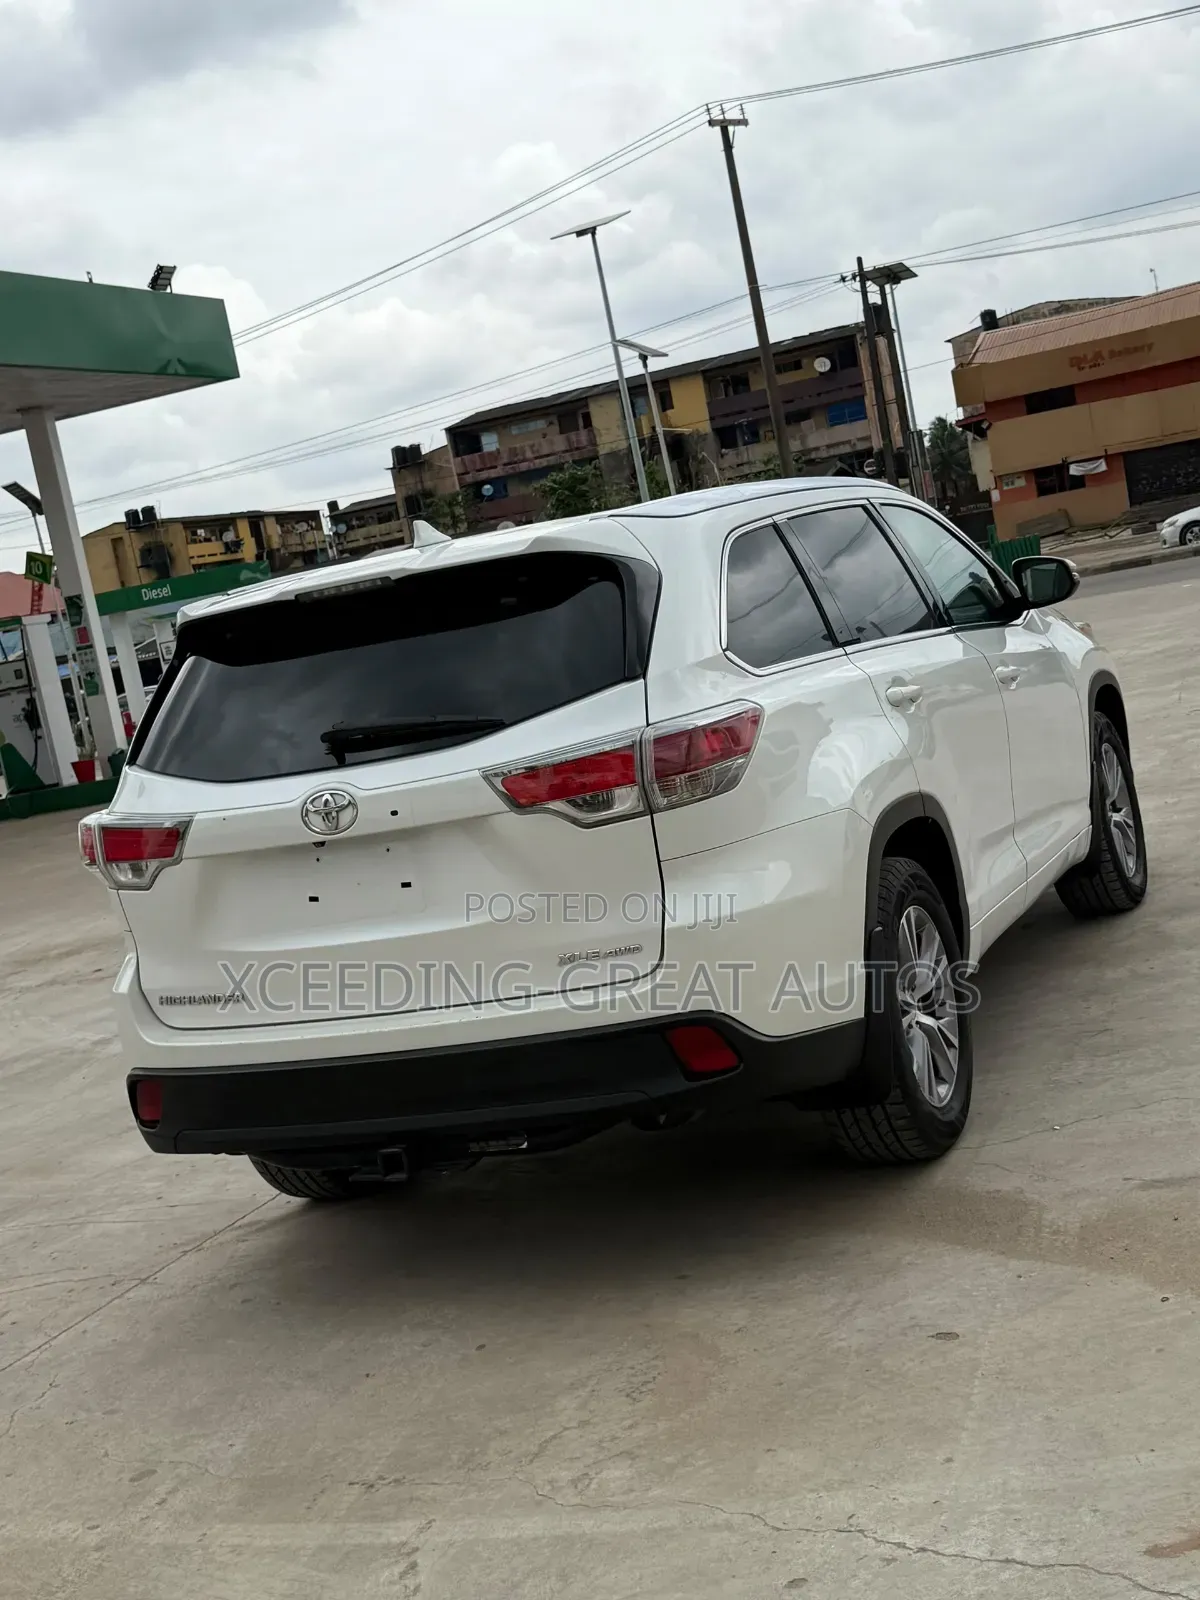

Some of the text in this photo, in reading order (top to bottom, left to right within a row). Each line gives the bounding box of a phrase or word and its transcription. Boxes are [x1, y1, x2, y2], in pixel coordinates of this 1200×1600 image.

[30, 560, 43, 575] 10
[141, 583, 172, 601] Diesel
[557, 943, 643, 967] XLE AWD
[158, 992, 245, 1006] HIGHLANDER
